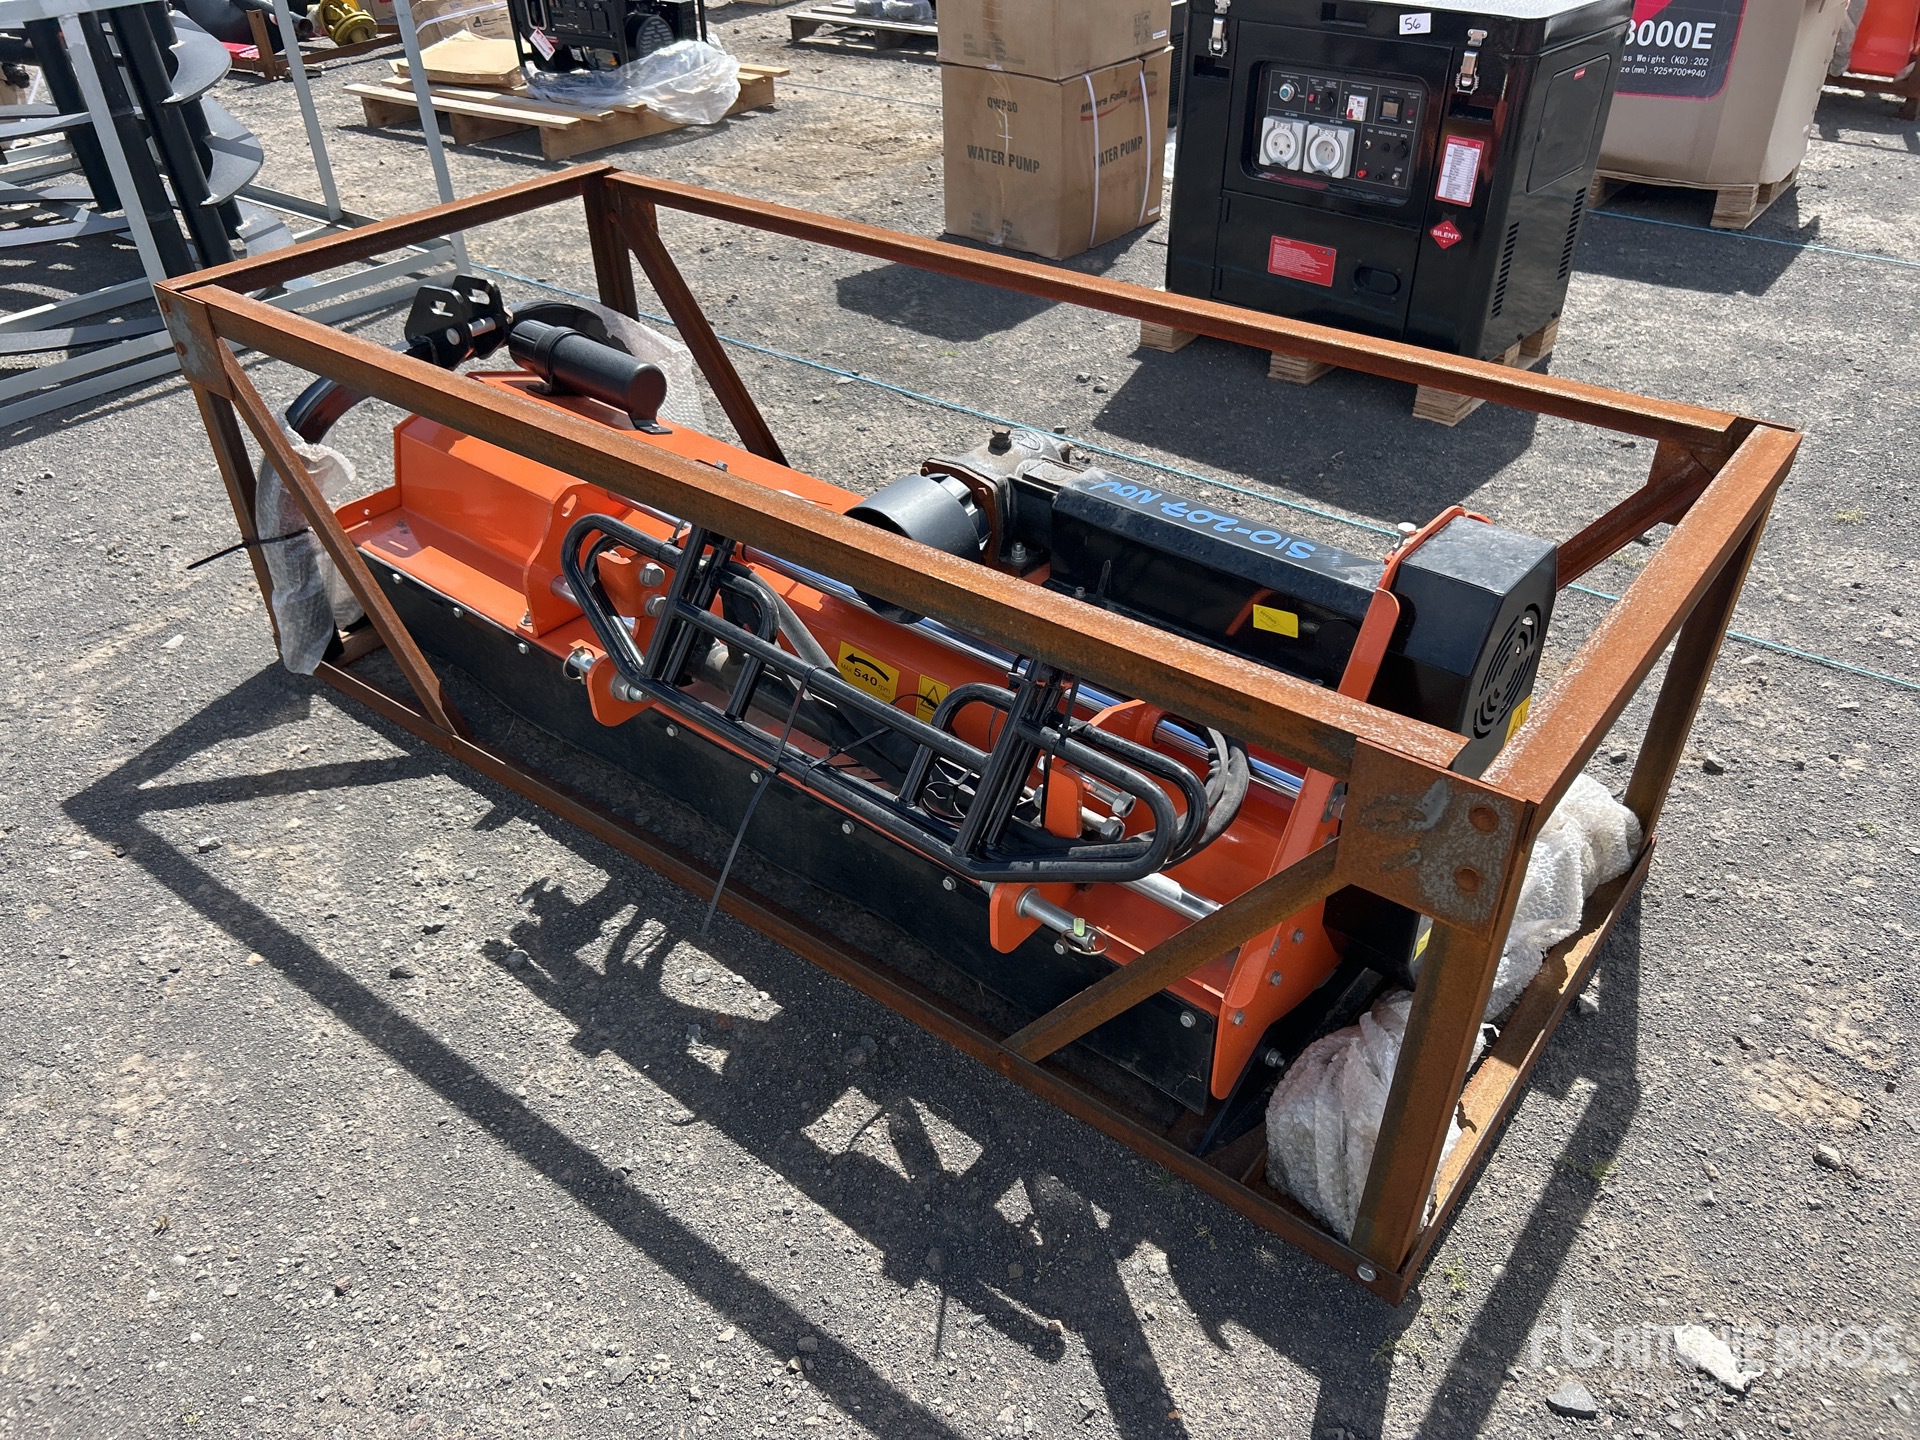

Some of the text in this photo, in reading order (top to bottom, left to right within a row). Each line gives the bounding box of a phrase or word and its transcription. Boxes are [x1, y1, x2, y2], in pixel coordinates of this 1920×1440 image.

[1405, 17, 1421, 31] 56
[1636, 54, 1665, 64] Weight
[1120, 136, 1143, 157] PUMP
[967, 145, 1040, 174] WATER PUMP
[1433, 230, 1458, 240] SILENT
[1089, 481, 1162, 504] NOV
[840, 663, 891, 694] MAX 540 rpm
